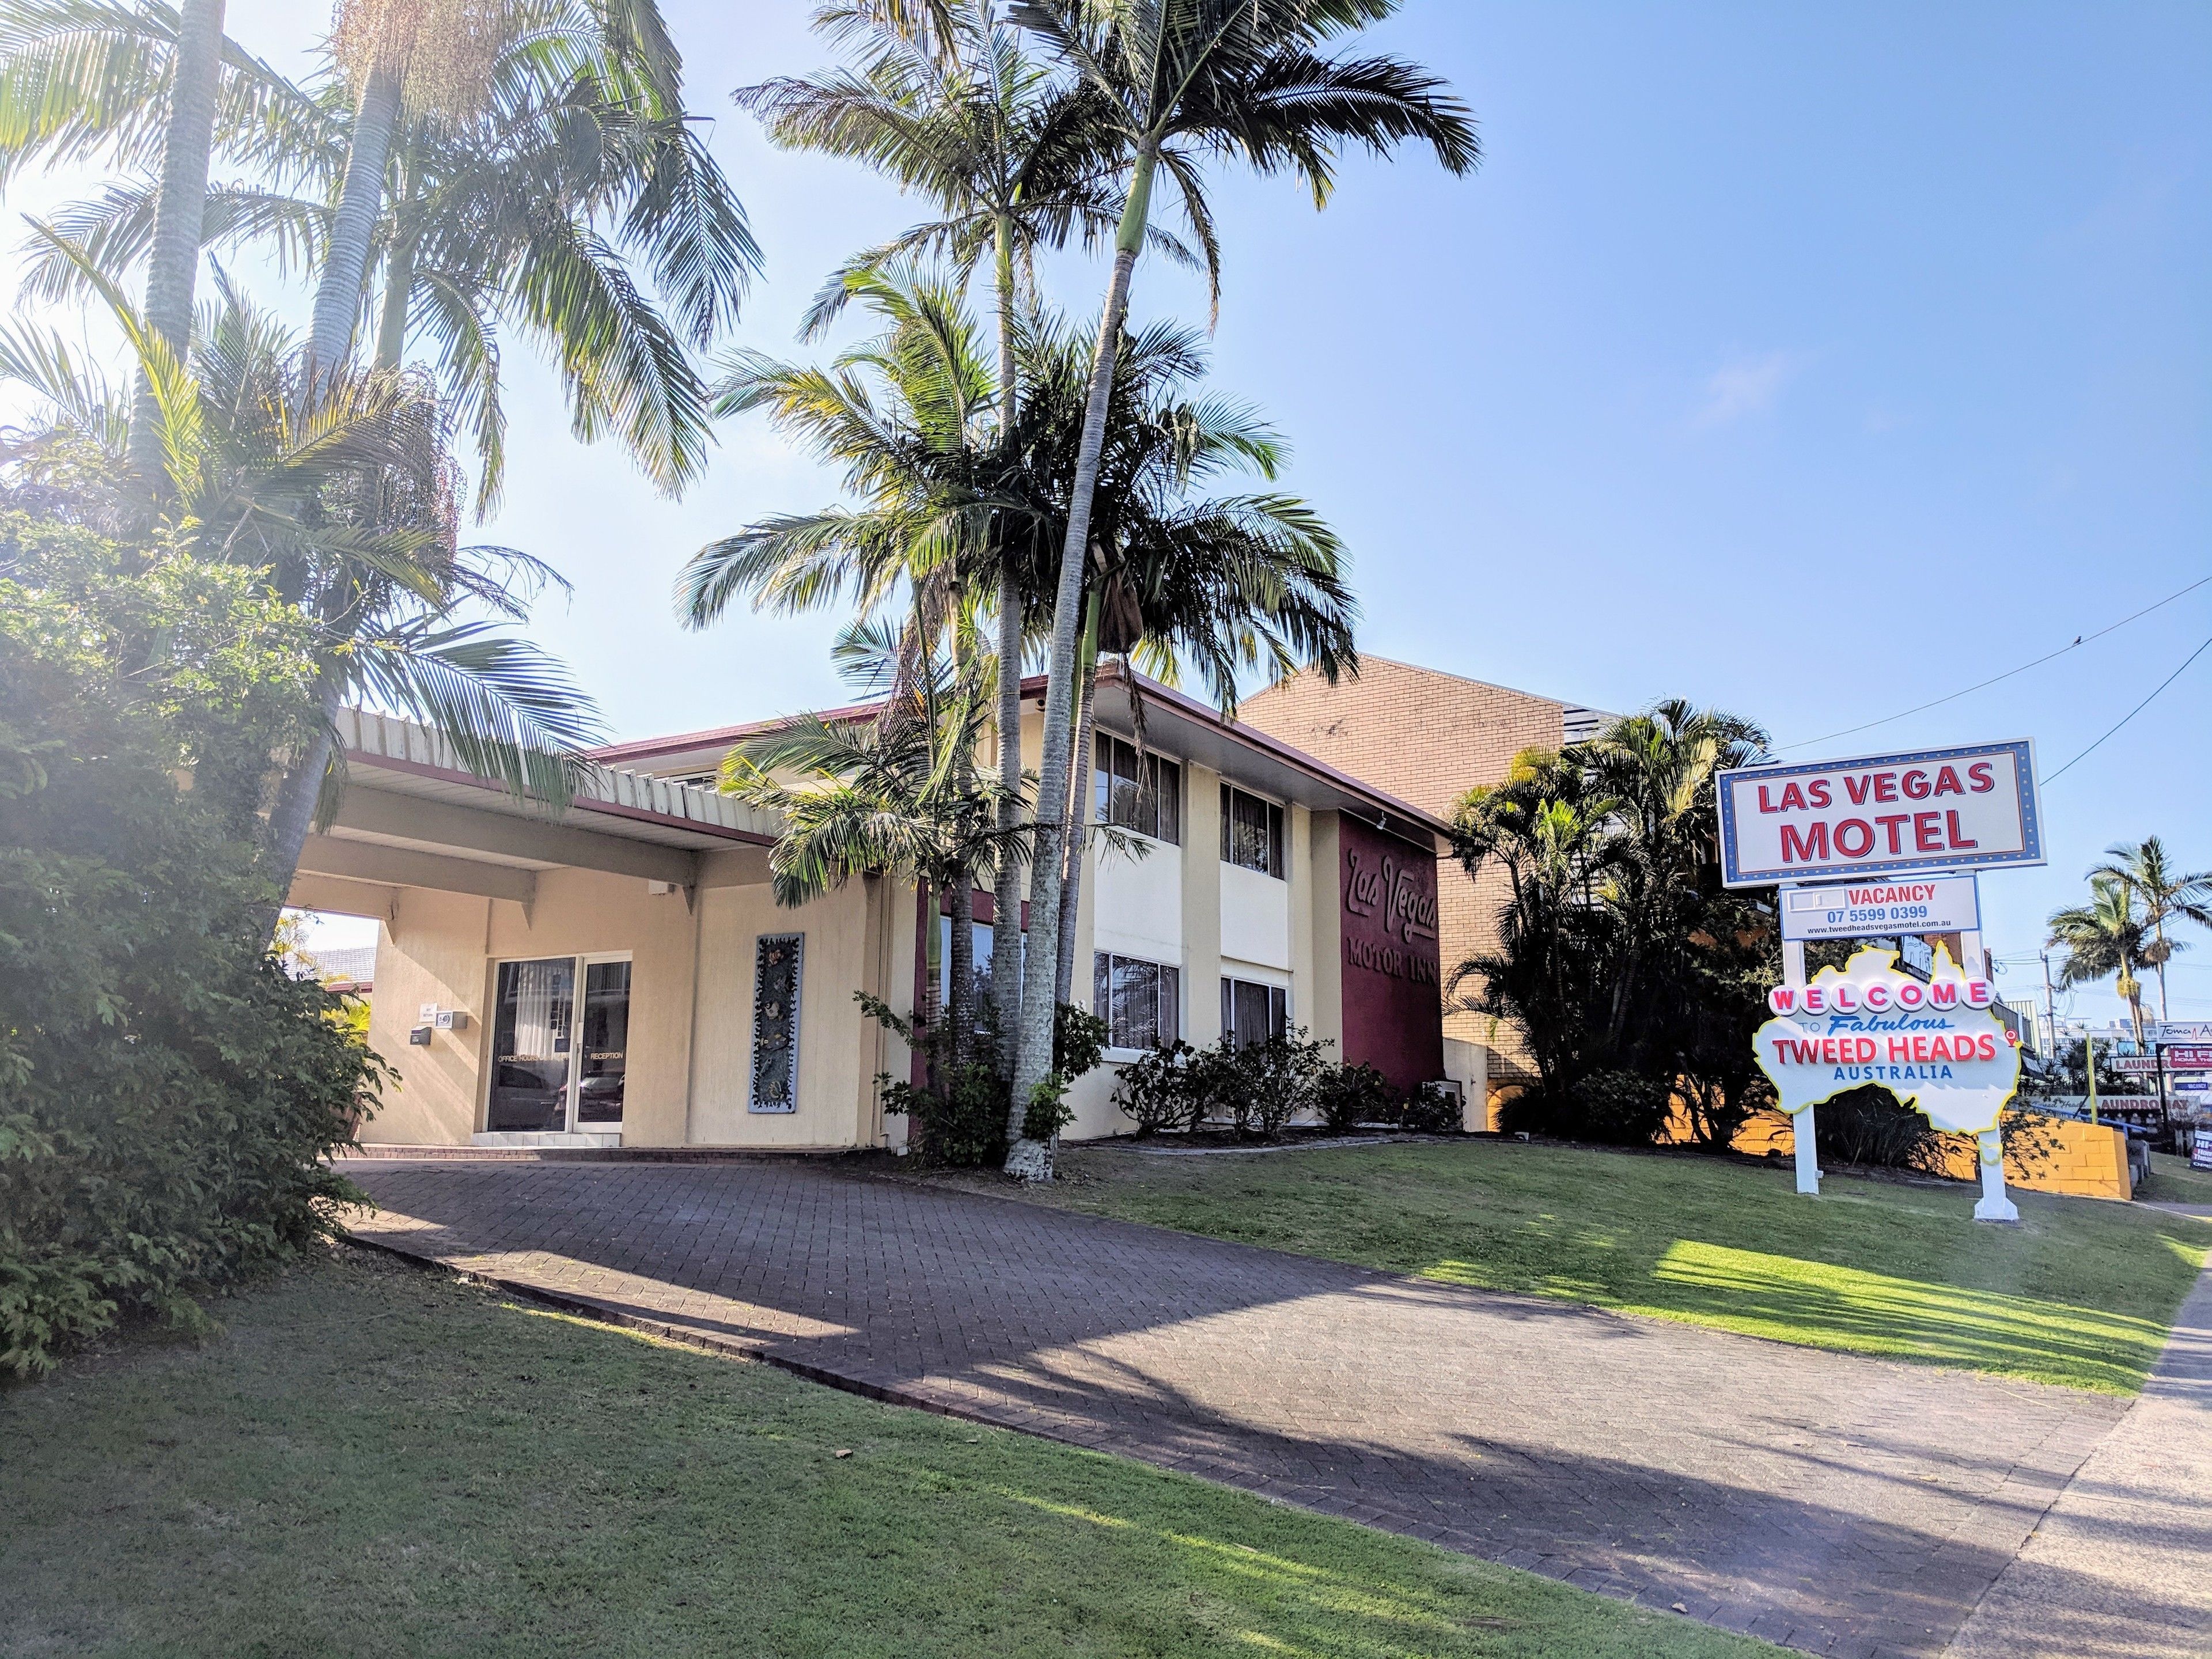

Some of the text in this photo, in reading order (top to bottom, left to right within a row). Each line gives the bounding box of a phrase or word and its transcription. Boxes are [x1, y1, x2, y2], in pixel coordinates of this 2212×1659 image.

[1758, 763, 1994, 813] LAS VEGAS
[1780, 810, 1978, 863] MOTEL
[1347, 848, 1436, 945] Las Vegas
[1848, 884, 1936, 905] VACANCY
[1827, 906, 1927, 923] 07 5599 0399
[1807, 921, 1951, 934] www.tweedheadsvegasmotel.com.au
[1348, 937, 1437, 986] MOTOR INN
[1773, 982, 1989, 1010] WELCOME
[1799, 1014, 1955, 1036] TO Fabulous
[590, 1052, 623, 1060] RECEPTION
[1772, 1035, 1997, 1065] TWEED HEADS
[1834, 1065, 1953, 1080] AUSTRALIA
[2116, 1059, 2171, 1070] LAUNDR
